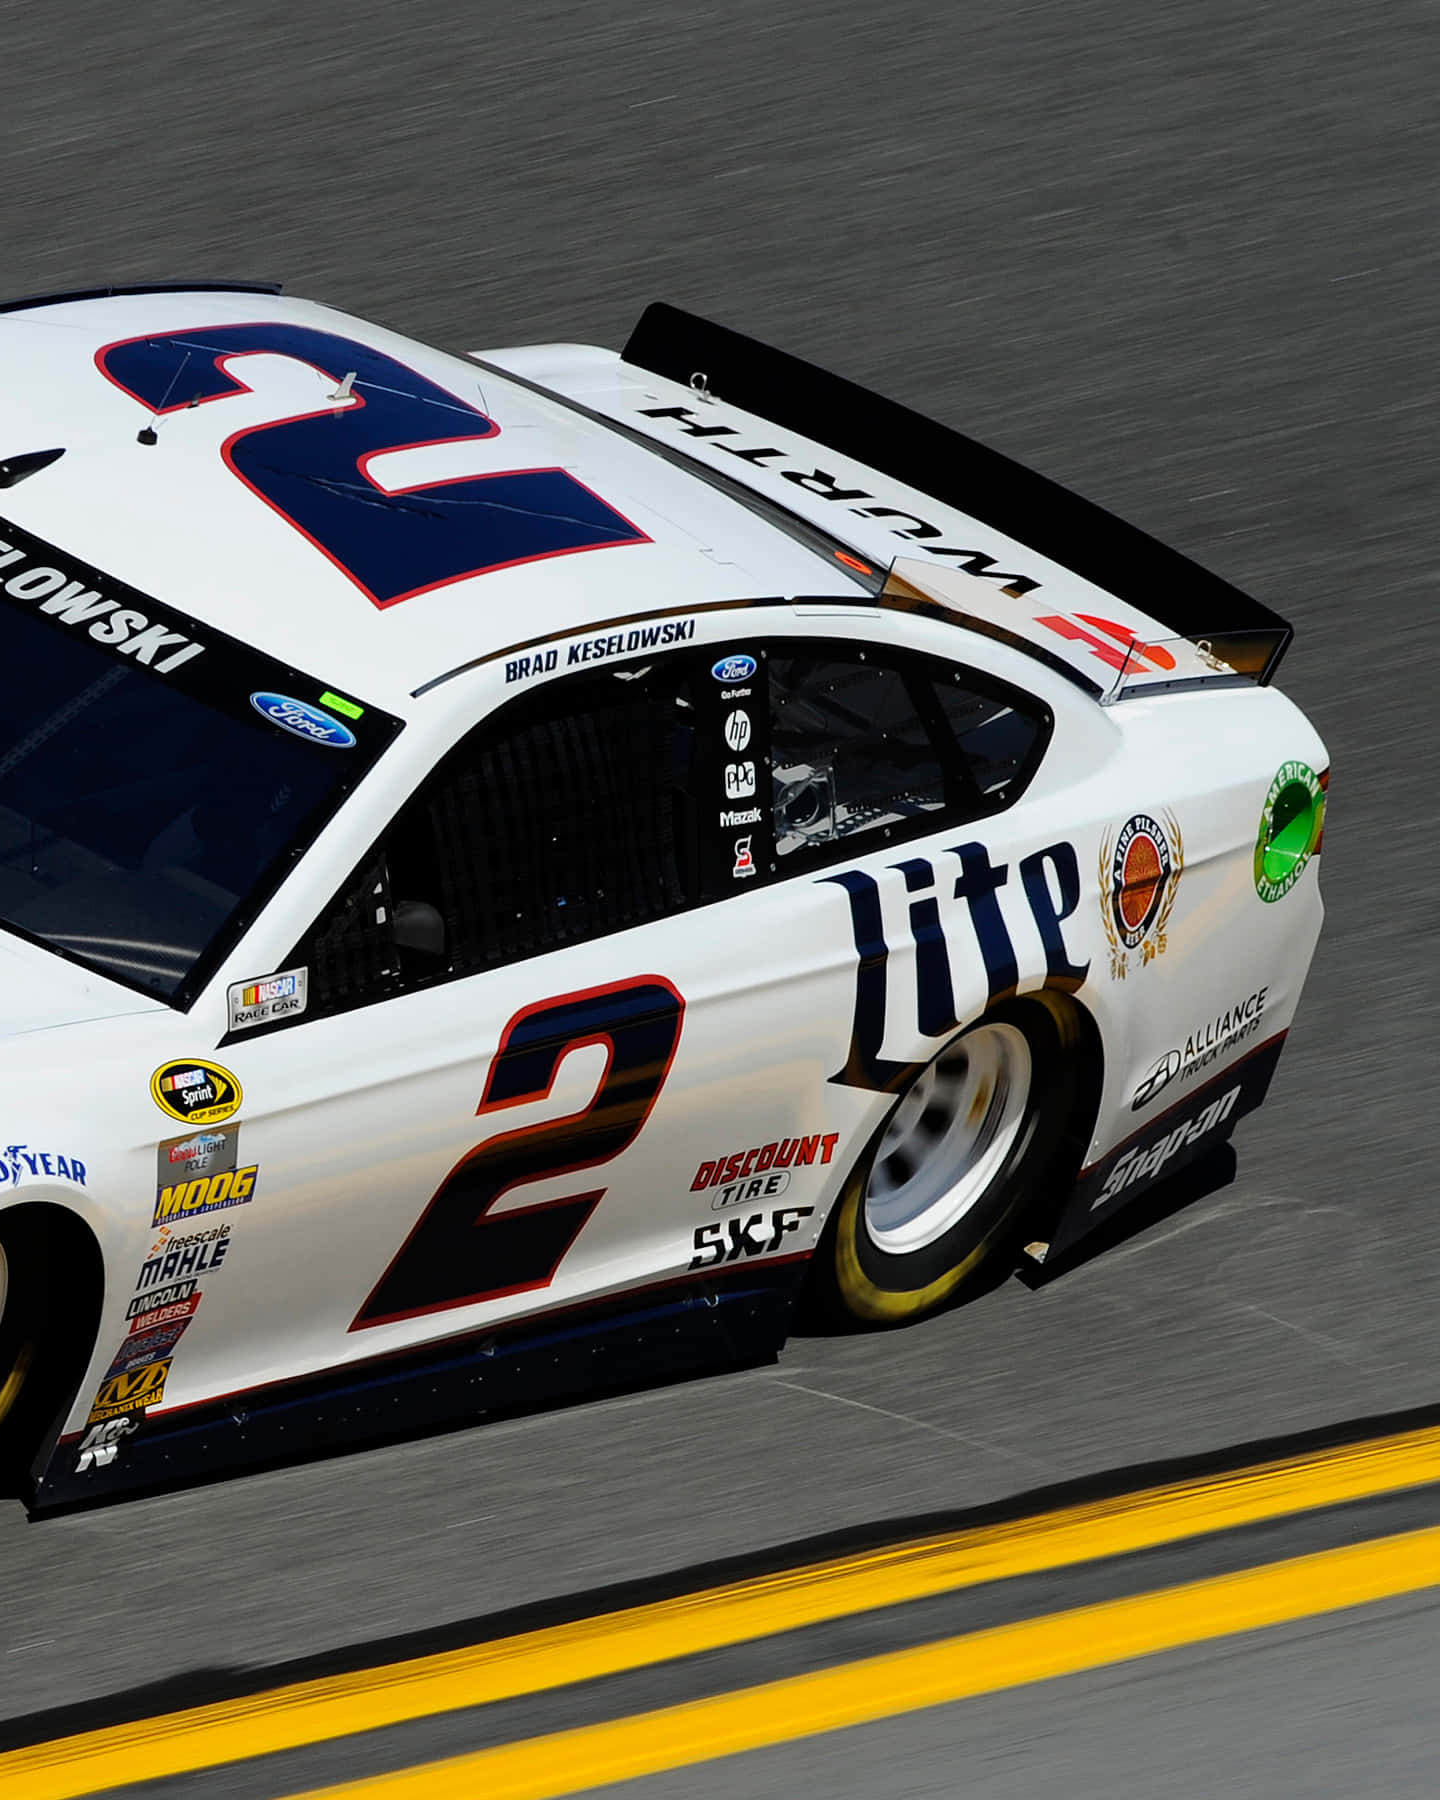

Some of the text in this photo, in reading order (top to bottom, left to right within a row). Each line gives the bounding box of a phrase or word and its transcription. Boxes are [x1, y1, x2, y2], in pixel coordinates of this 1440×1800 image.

[93, 321, 656, 611] 2
[505, 619, 696, 684] BRAD KESELOWSKI
[720, 807, 762, 828] Mazak
[1264, 762, 1320, 826] AMERICAN
[1257, 851, 1312, 901] ETHANOL
[812, 841, 1091, 1095] Lite
[235, 999, 299, 1023] RACE CAR
[1183, 986, 1269, 1062] ALLIANCE
[182, 1084, 214, 1107] Sprint
[185, 1157, 209, 1173] POLE
[346, 973, 687, 1333] 2
[690, 1132, 840, 1192] DISCOUNT
[156, 1165, 257, 1219] MOOG
[721, 1175, 782, 1206] TIRE
[165, 1223, 231, 1253] freescale
[688, 1206, 815, 1270] SKF
[136, 1239, 231, 1291] MAHLE
[129, 1282, 193, 1318] LINCOLN
[135, 1302, 192, 1330] WELDERS
